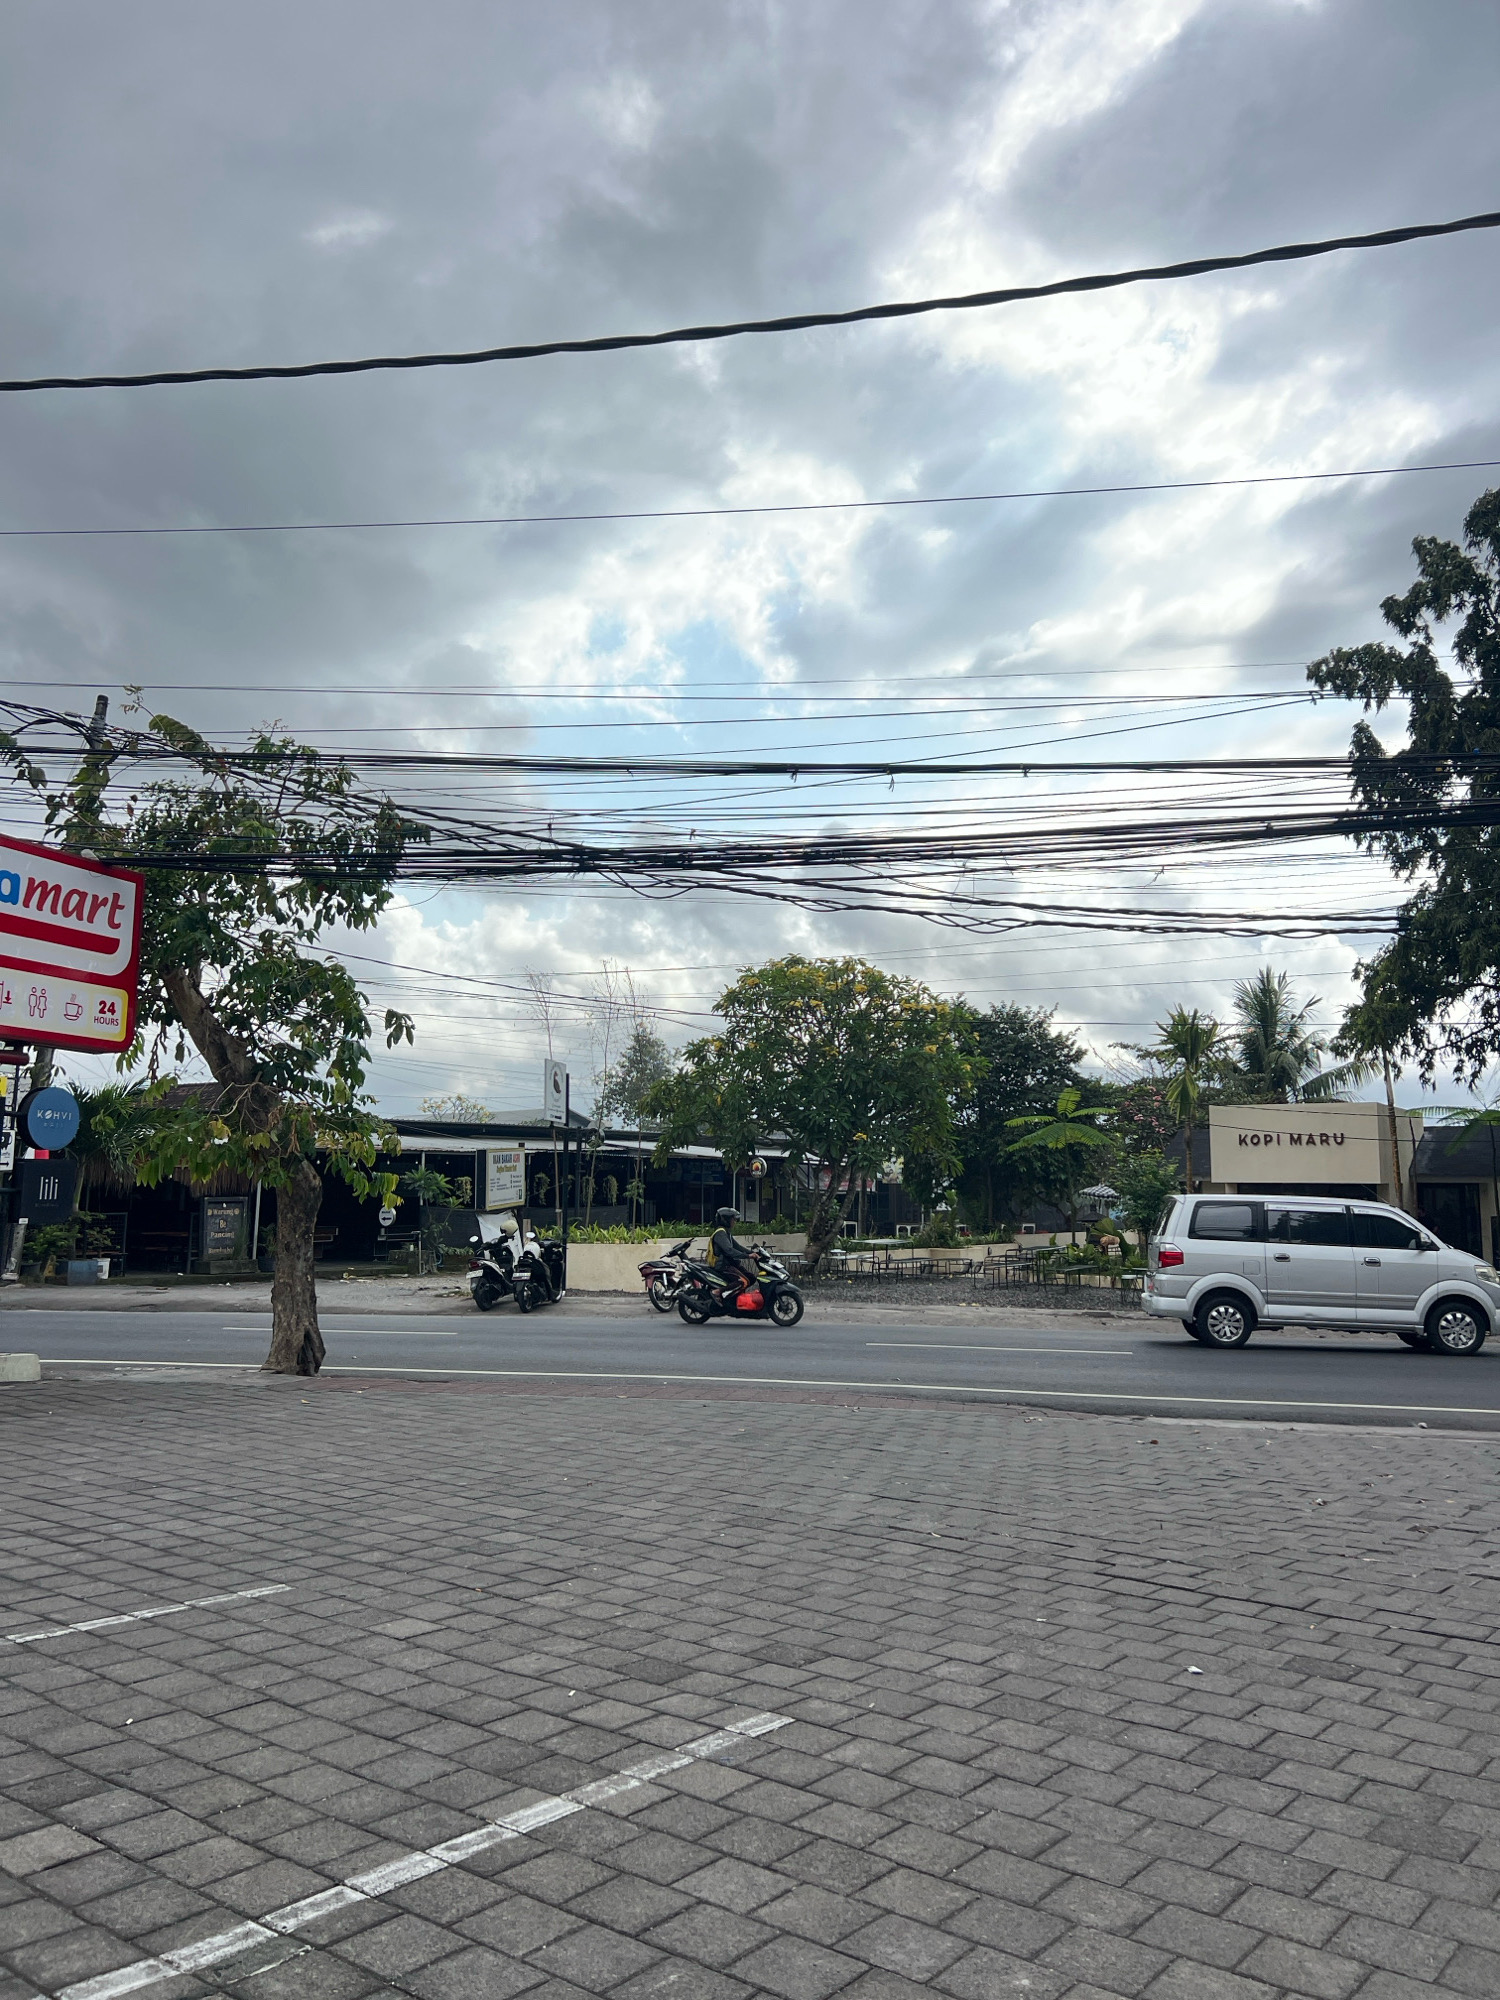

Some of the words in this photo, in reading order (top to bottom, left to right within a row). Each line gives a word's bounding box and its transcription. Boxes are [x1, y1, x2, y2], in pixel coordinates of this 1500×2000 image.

[98, 1000, 116, 1016] 24
[94, 1015, 119, 1027] HOURS
[37, 1109, 72, 1120] KOHVI
[1239, 1133, 1280, 1146] KOPI
[1289, 1133, 1344, 1146] MARU
[39, 1176, 58, 1200] lili
